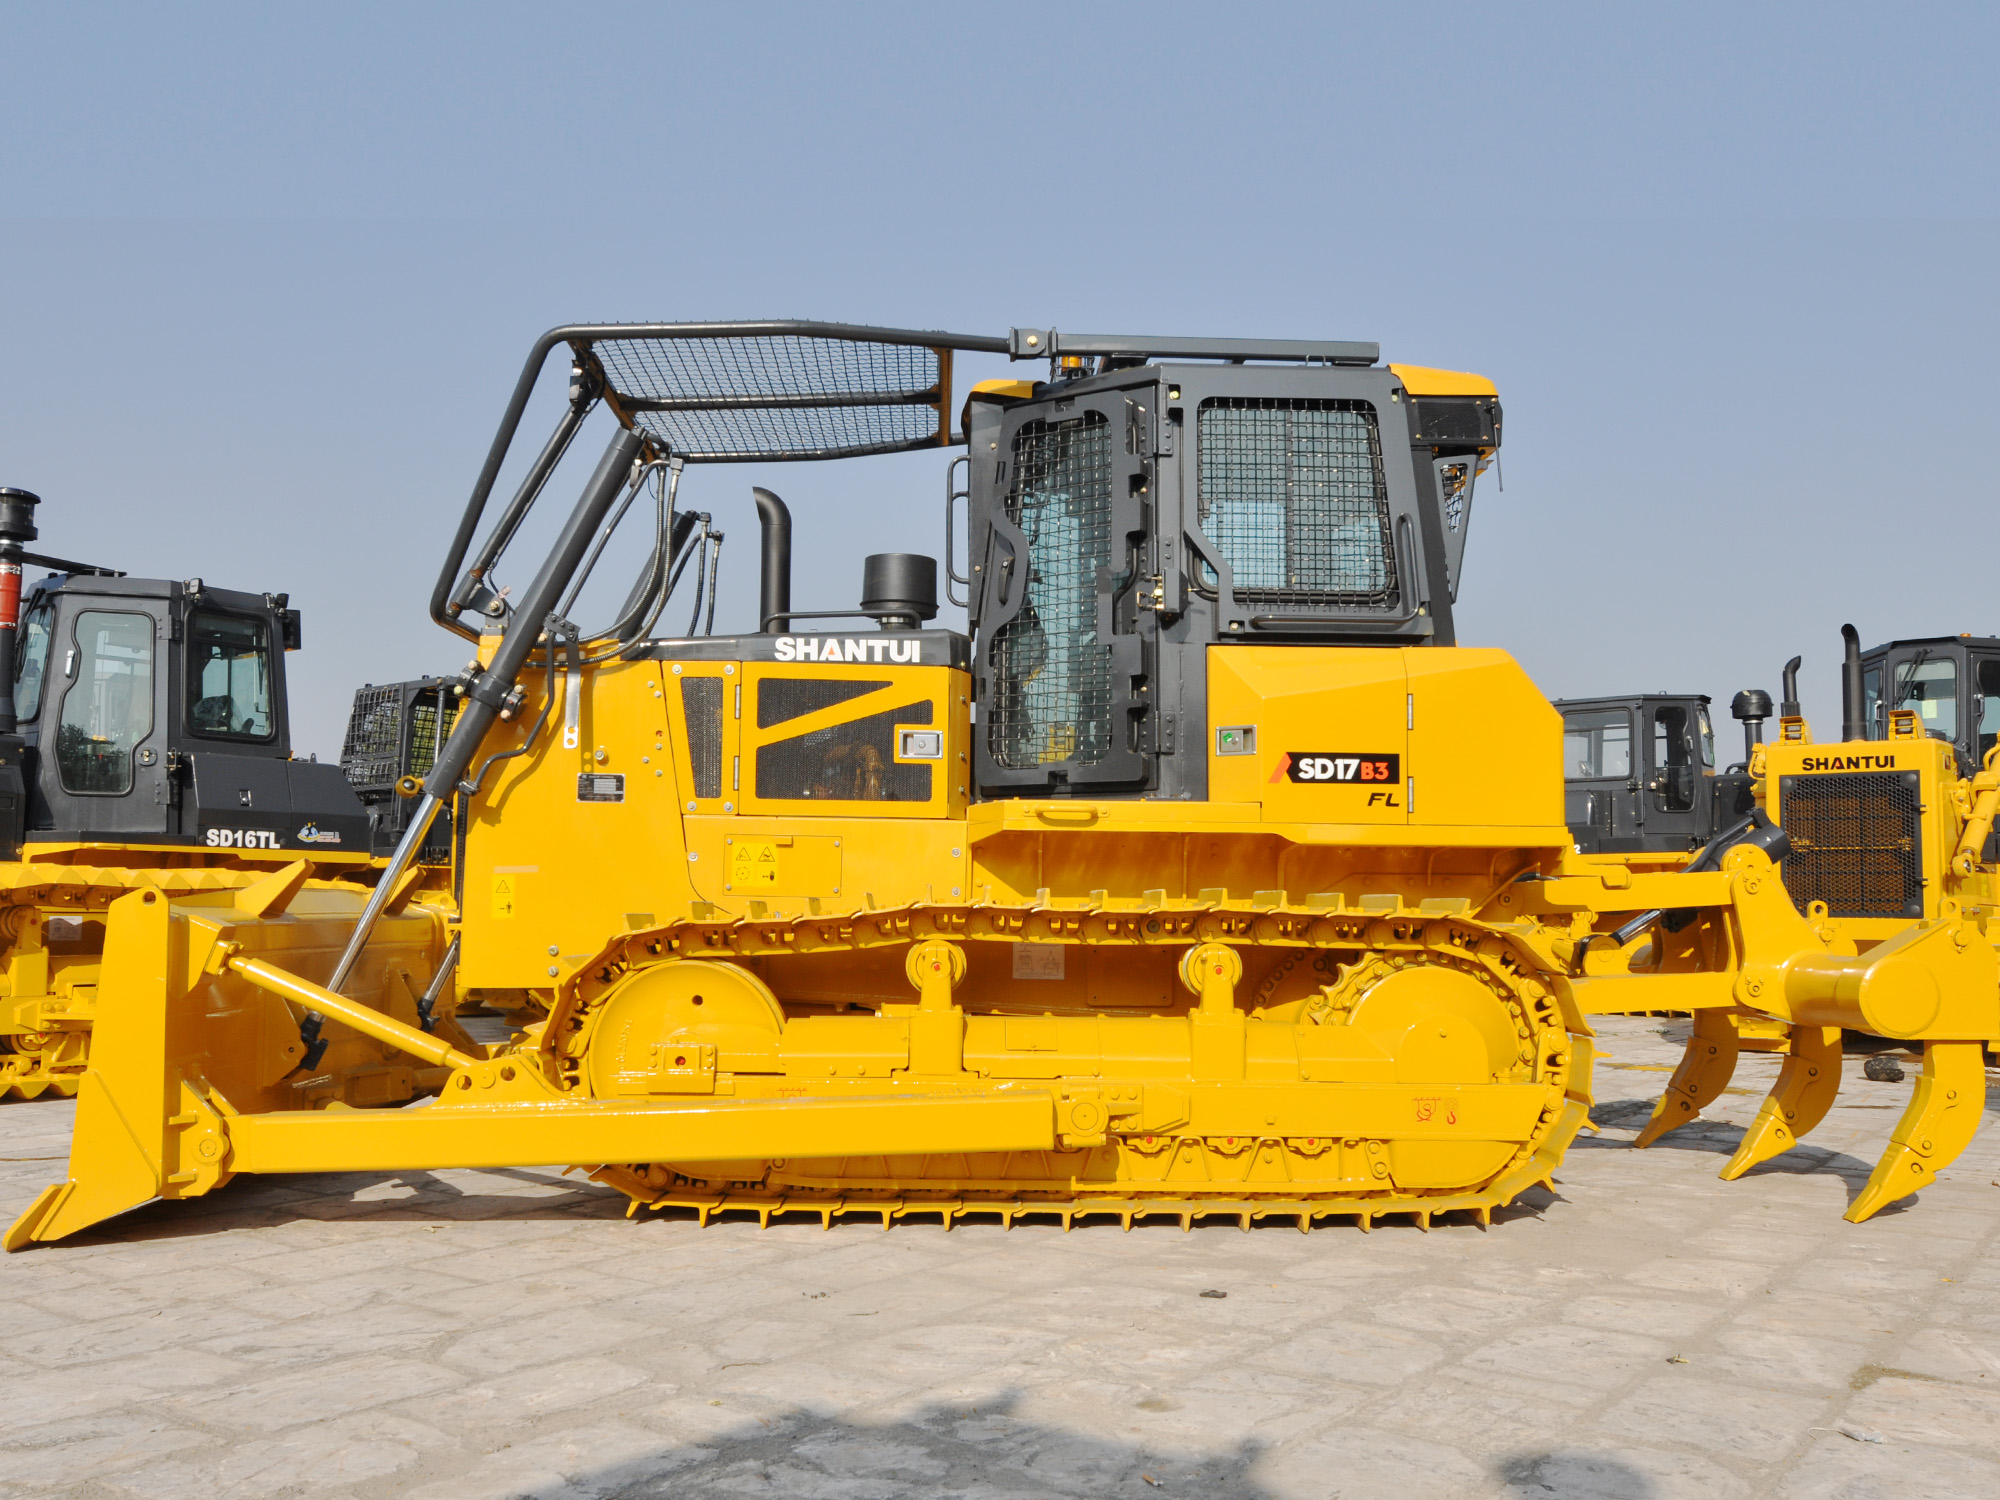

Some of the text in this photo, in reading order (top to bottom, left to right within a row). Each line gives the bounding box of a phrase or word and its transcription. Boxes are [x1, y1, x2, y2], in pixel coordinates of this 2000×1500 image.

[774, 636, 921, 663] SHANTUI
[1802, 755, 1895, 771] SHANTUI
[1367, 792, 1400, 807] FL
[206, 828, 281, 849] SD16TL
